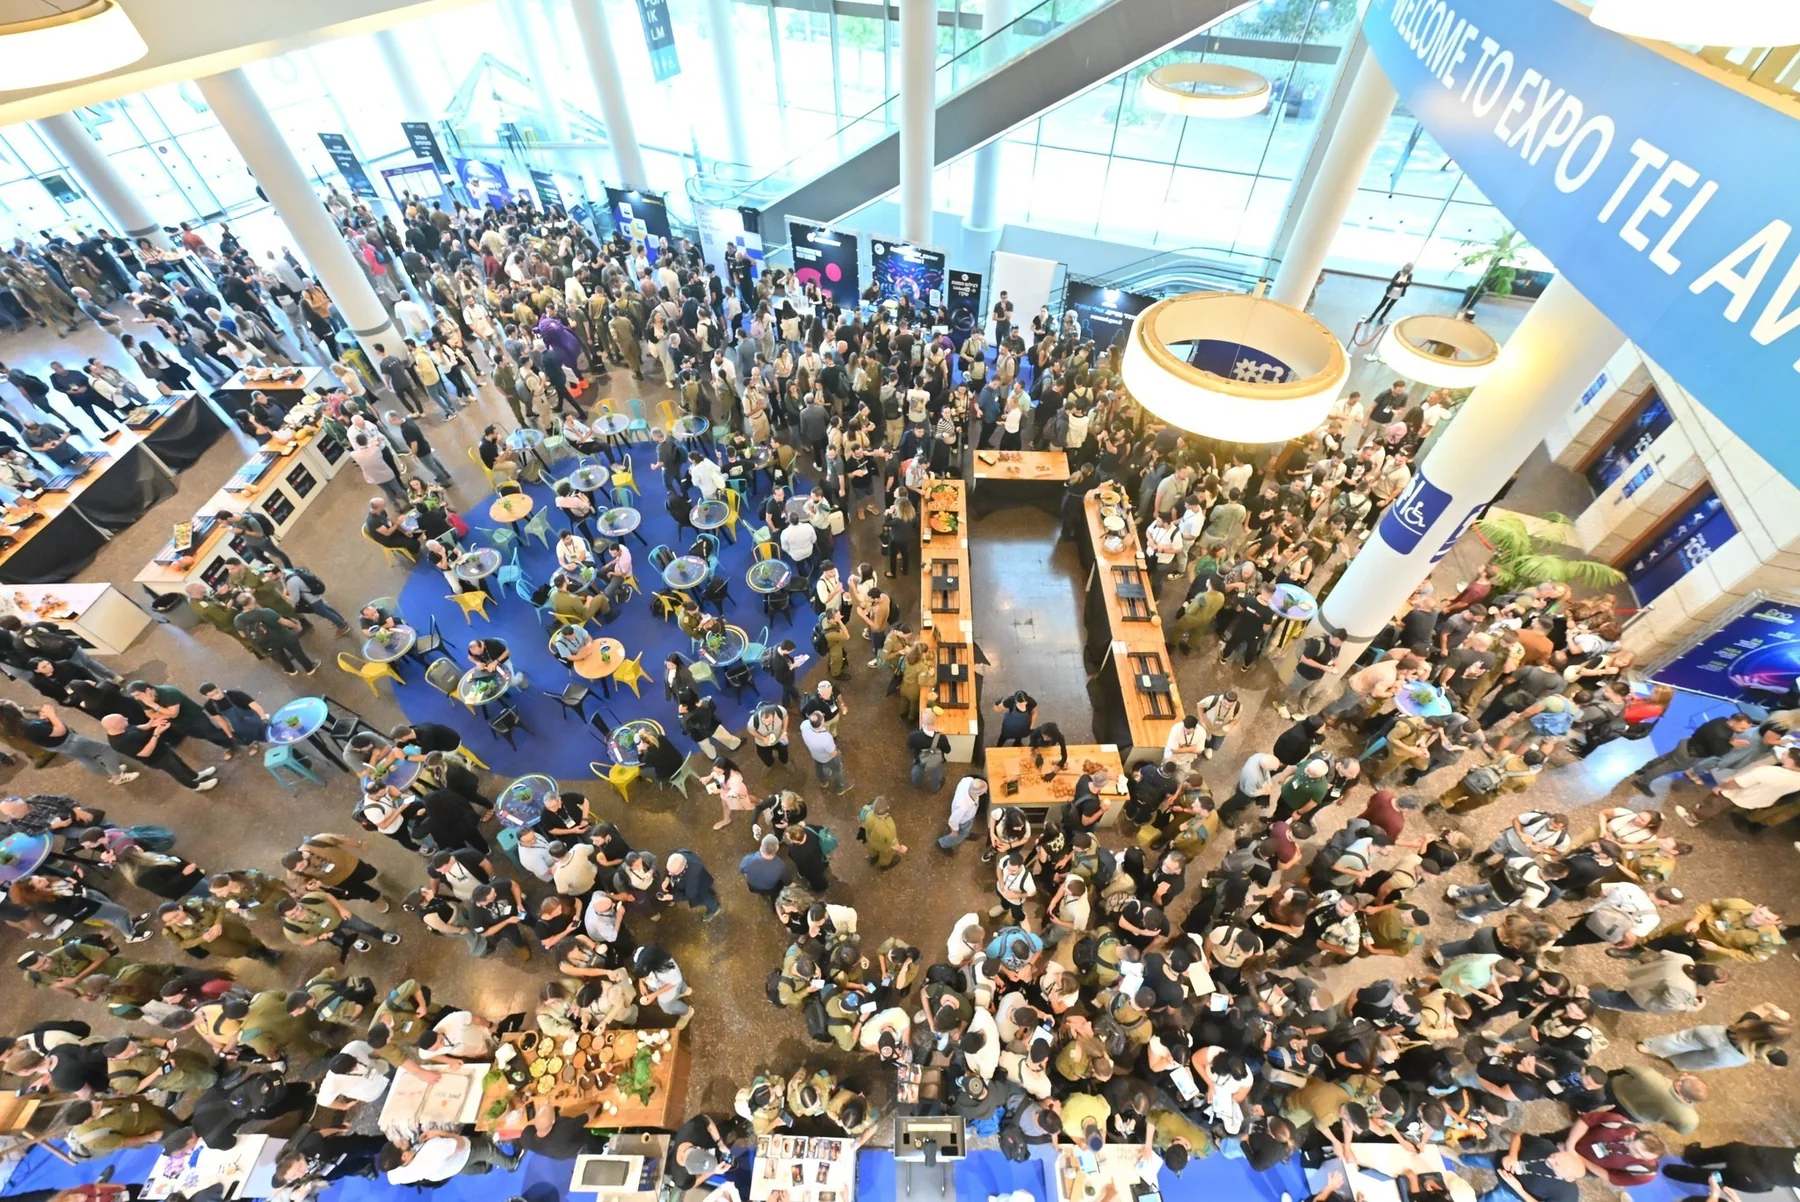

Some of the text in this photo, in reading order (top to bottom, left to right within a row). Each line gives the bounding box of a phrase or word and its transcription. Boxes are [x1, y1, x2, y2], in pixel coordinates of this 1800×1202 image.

[650, 25, 665, 40] LM
[1390, 0, 1800, 373] WELCOME TO EXPO TEL AV
